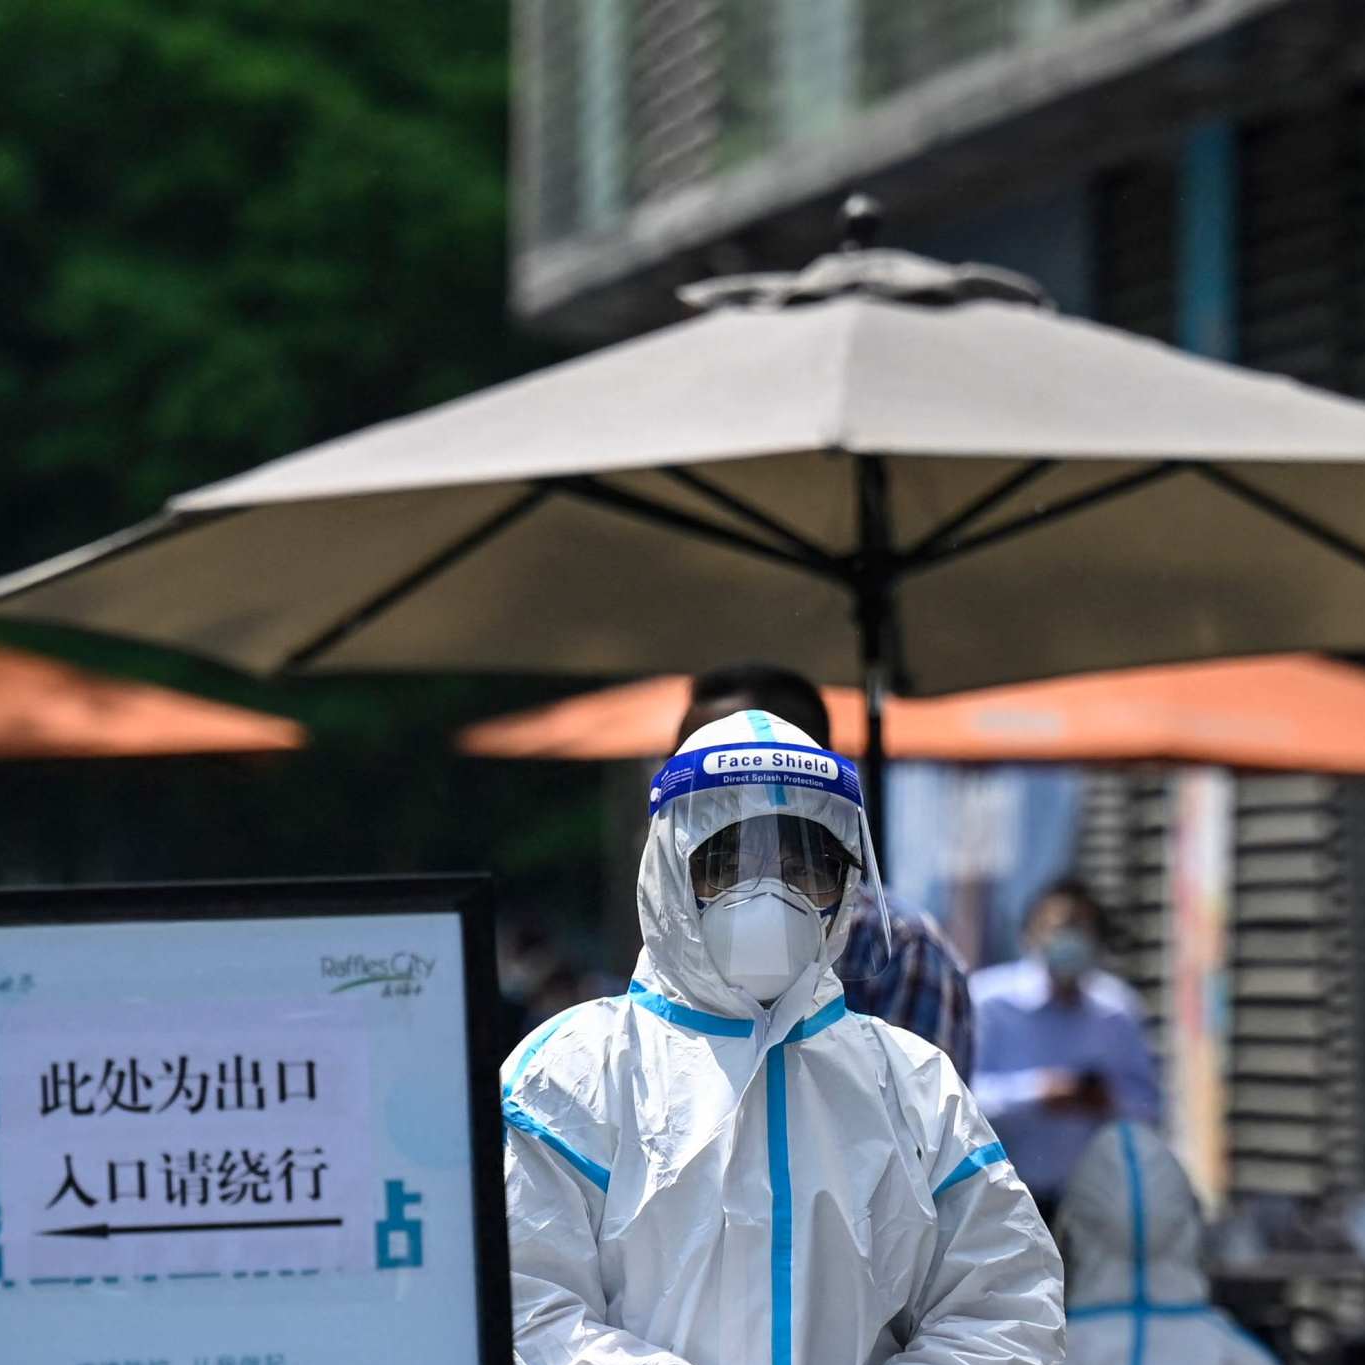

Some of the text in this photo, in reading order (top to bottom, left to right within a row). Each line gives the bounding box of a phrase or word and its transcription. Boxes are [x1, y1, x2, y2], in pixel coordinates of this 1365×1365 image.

[717, 752, 829, 774] Face Shield
[723, 774, 824, 788] Direct Splash Protection
[39, 1055, 318, 1118] 此处为出口
[45, 1147, 329, 1210] 入口请绕行
